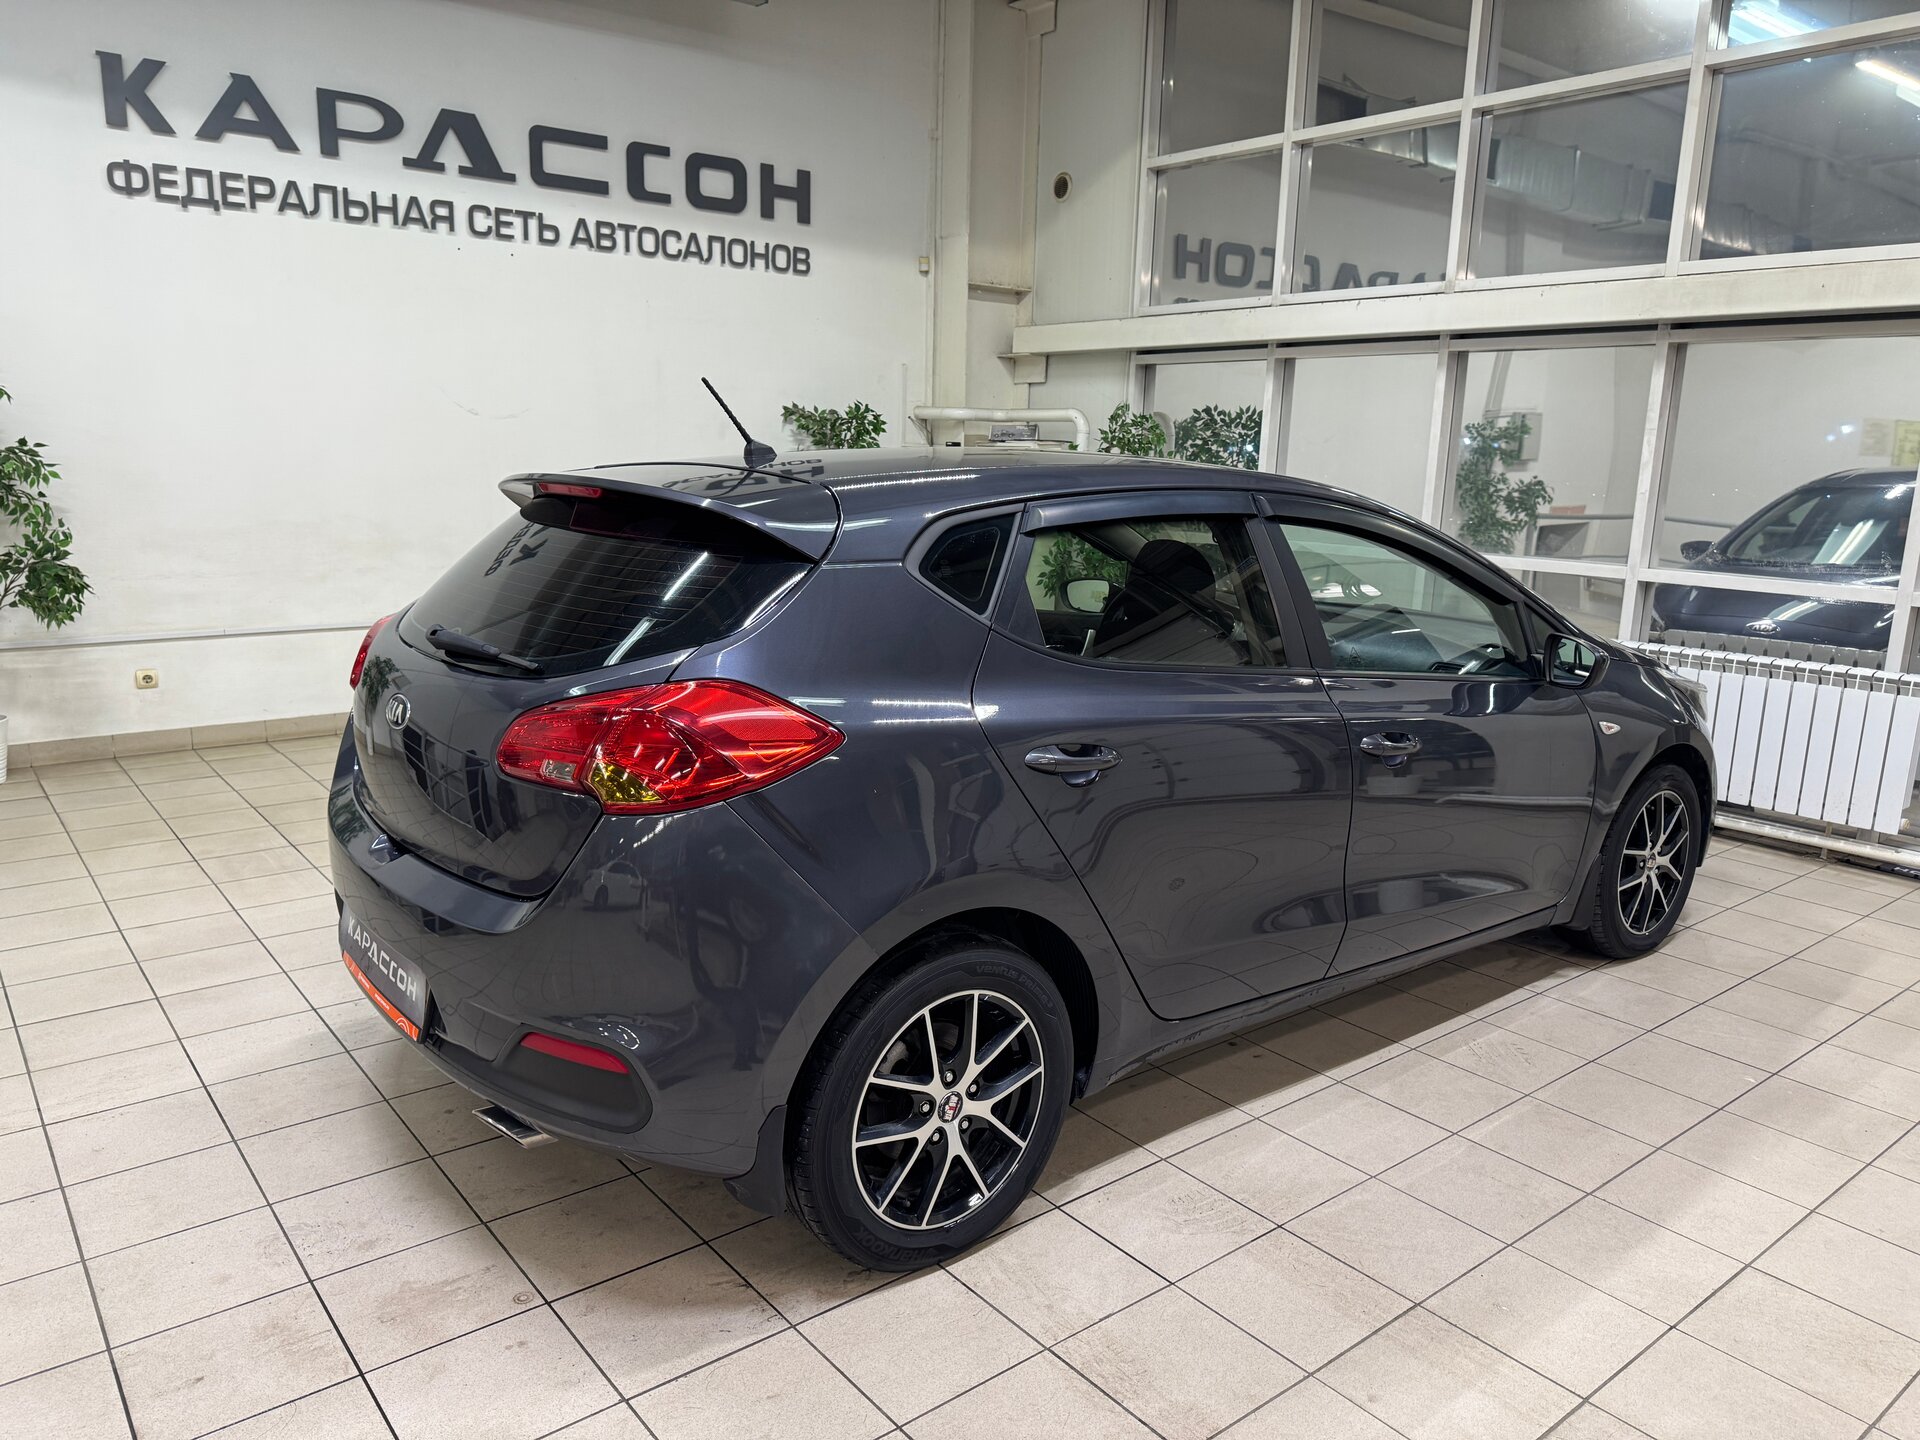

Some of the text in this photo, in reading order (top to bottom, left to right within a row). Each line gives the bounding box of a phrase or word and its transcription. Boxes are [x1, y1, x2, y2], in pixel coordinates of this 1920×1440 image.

[95, 50, 811, 225] КАРАССОН
[106, 159, 812, 275] ФЕДЕРАЛЬНАЯ СЕТЬ АВТОСАЛОНОВ
[348, 916, 417, 1001] КАРАССОН
